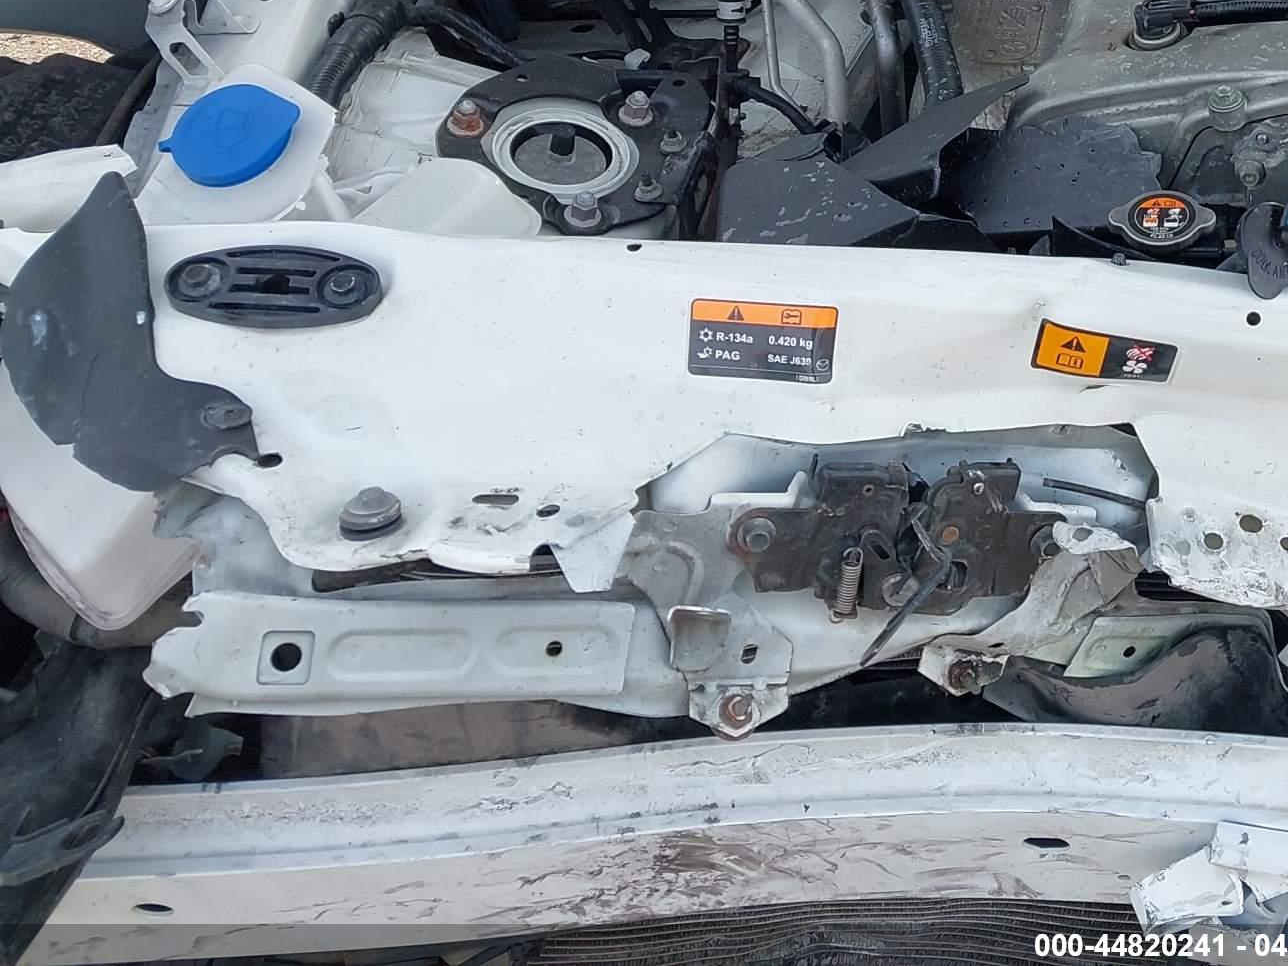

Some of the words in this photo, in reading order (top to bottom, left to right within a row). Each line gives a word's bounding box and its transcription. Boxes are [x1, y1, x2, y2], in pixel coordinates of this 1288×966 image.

[716, 331, 754, 344] R-134a
[768, 335, 797, 347] 0.420
[799, 337, 814, 351] kg
[715, 349, 741, 361] PAG
[768, 353, 788, 364] SAE
